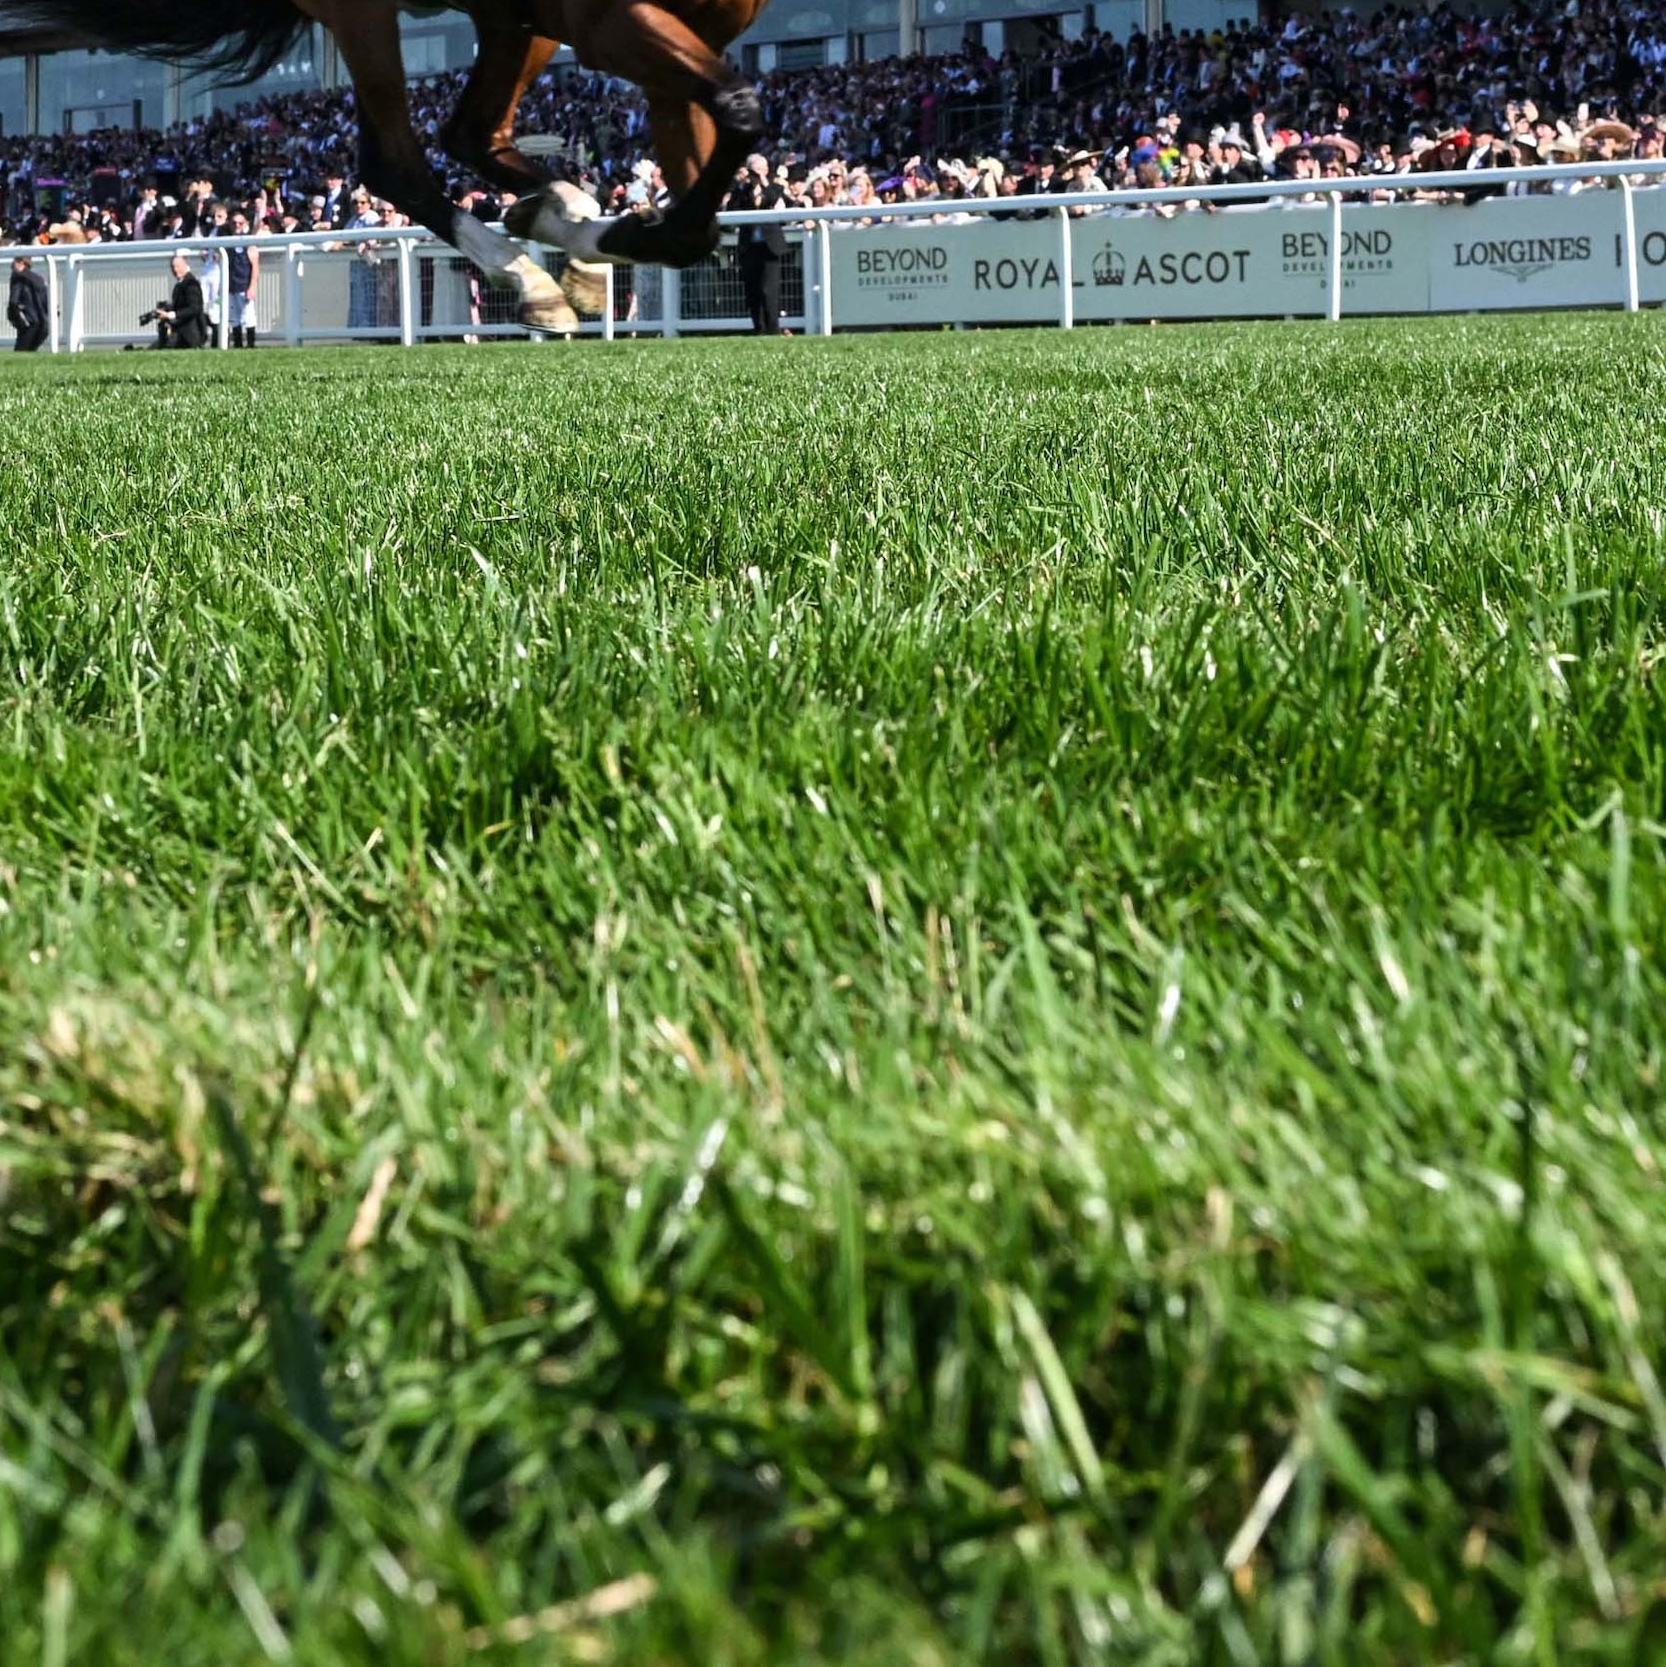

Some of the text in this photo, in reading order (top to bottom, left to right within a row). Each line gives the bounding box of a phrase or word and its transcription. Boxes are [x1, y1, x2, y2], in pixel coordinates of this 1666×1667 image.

[1282, 230, 1392, 257] BEYOND
[1454, 236, 1591, 266] LONGINES
[857, 247, 947, 273] BEYOND
[1134, 251, 1250, 284] ASCOT
[1282, 260, 1393, 272] DEVELMENTS
[1320, 279, 1355, 289] DAI
